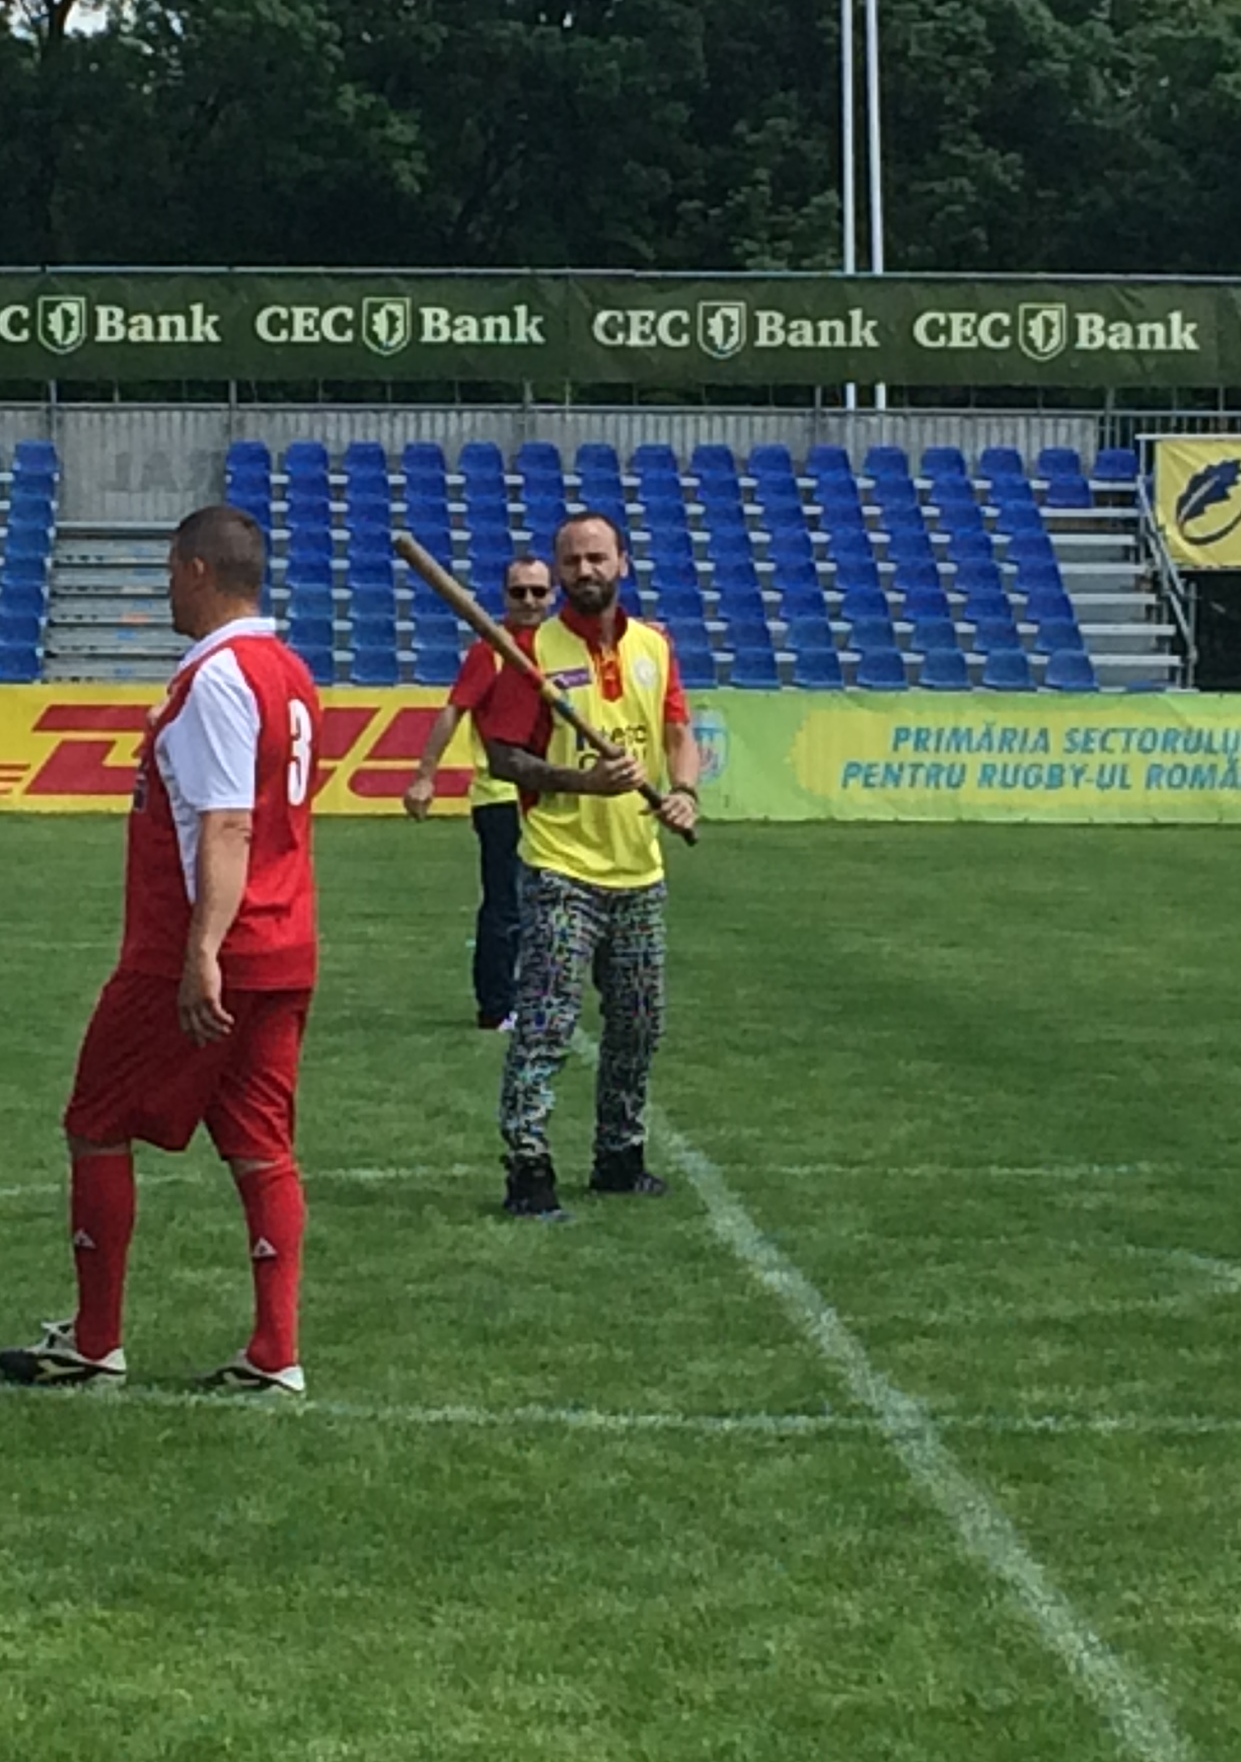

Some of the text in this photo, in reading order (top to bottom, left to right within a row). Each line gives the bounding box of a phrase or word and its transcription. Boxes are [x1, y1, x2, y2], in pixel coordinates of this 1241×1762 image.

[95, 303, 221, 341] Bank
[255, 304, 545, 343] CEC Bank
[593, 308, 880, 347] CEC Bank
[913, 311, 1201, 350] CEC Bank
[287, 698, 312, 806] 3
[892, 721, 1049, 754] PRIMĂRIA
[841, 761, 967, 790] PENTRU
[977, 763, 1132, 791] RUGBY-UL
